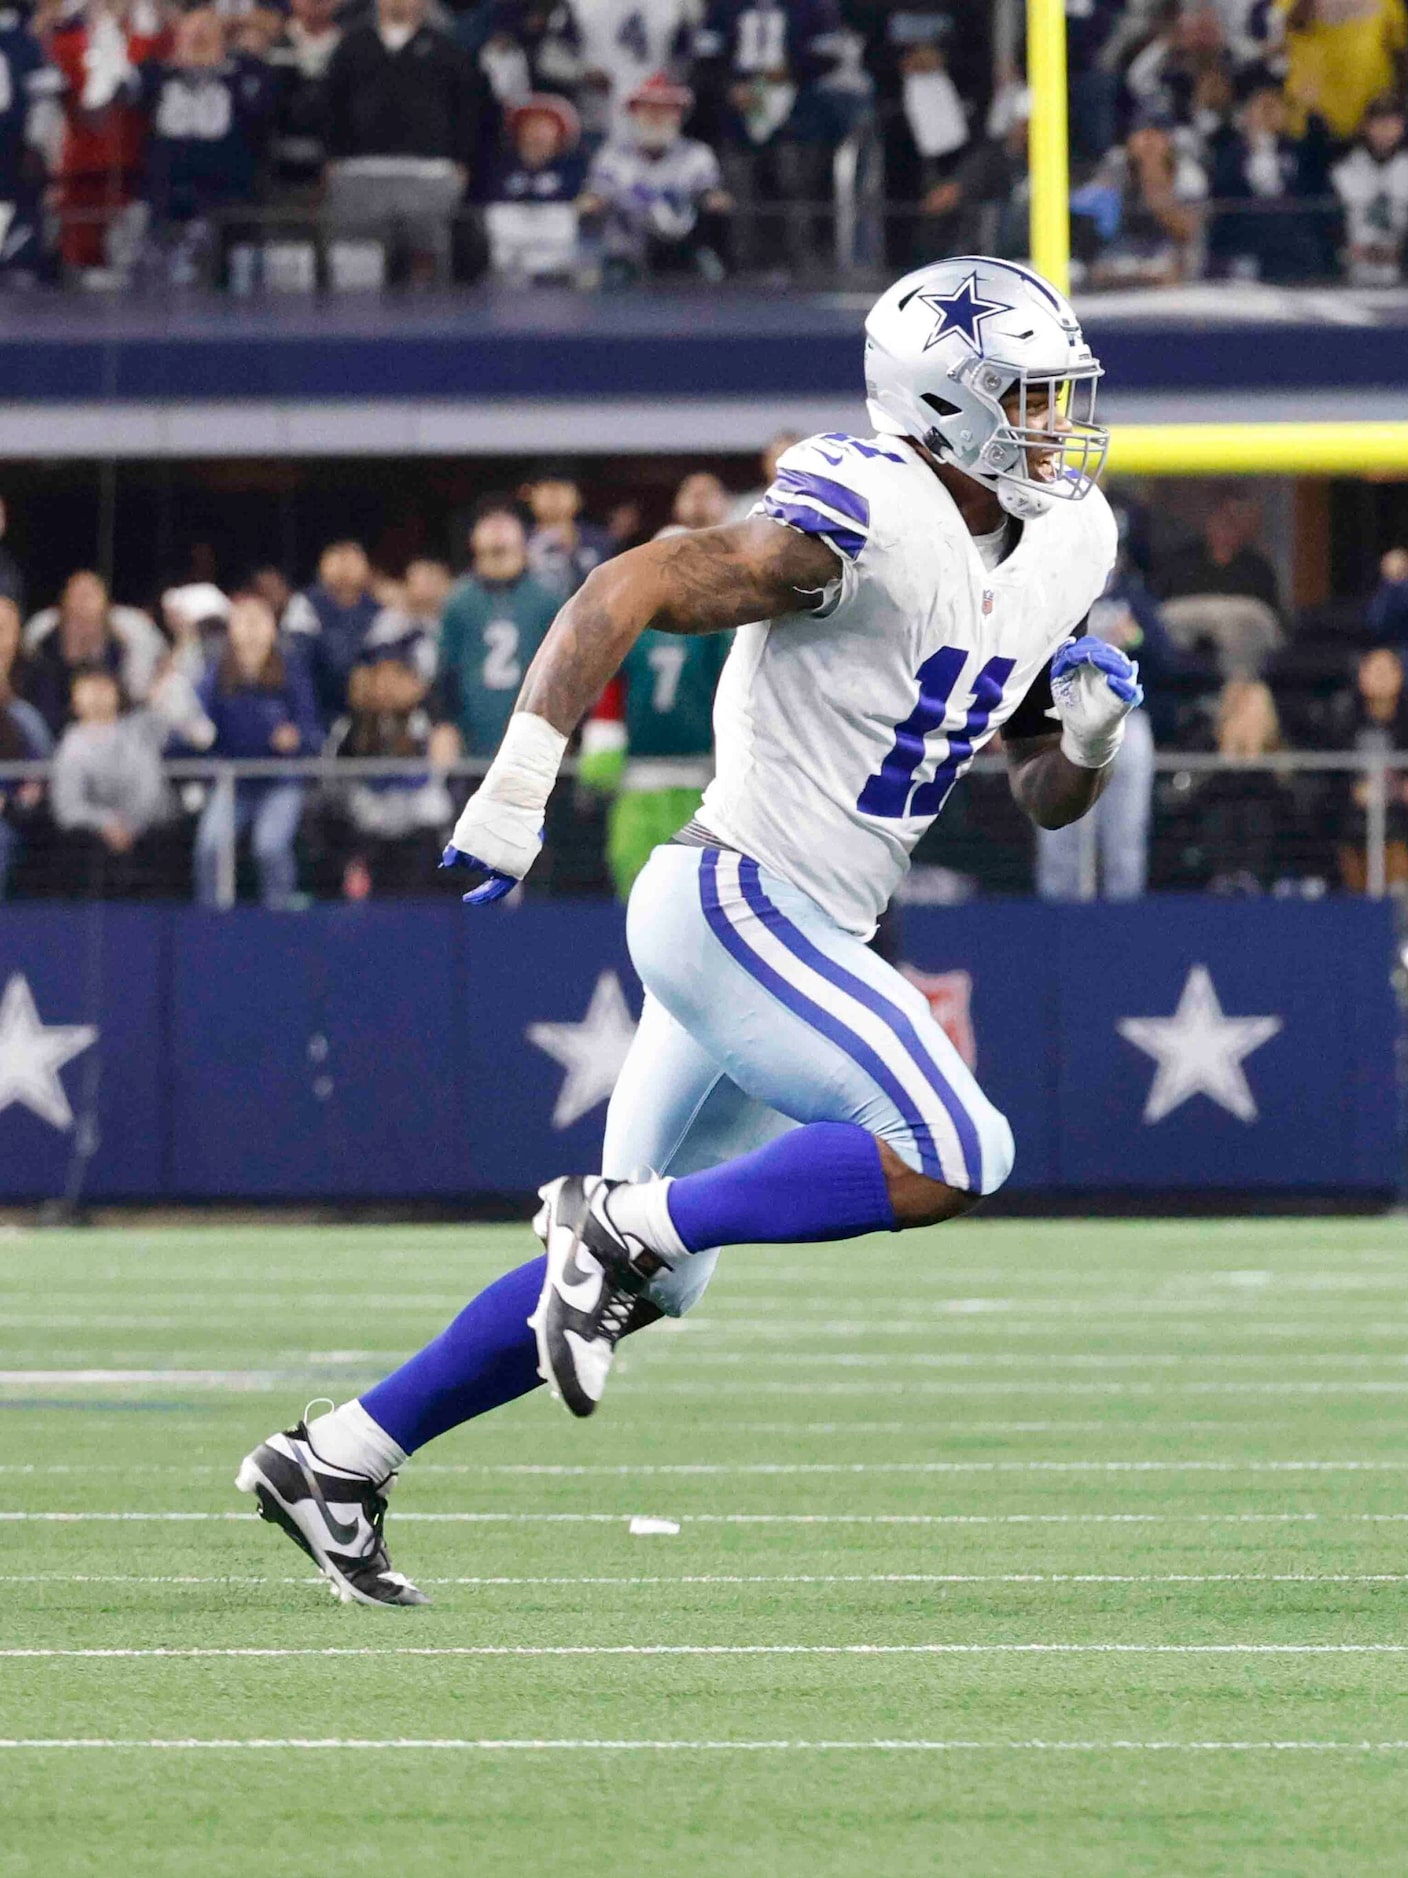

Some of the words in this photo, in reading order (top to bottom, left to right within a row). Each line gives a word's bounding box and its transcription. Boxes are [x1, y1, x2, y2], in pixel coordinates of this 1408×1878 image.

[483, 619, 521, 690] 2
[649, 645, 686, 713] 7
[856, 645, 1017, 818] 11
